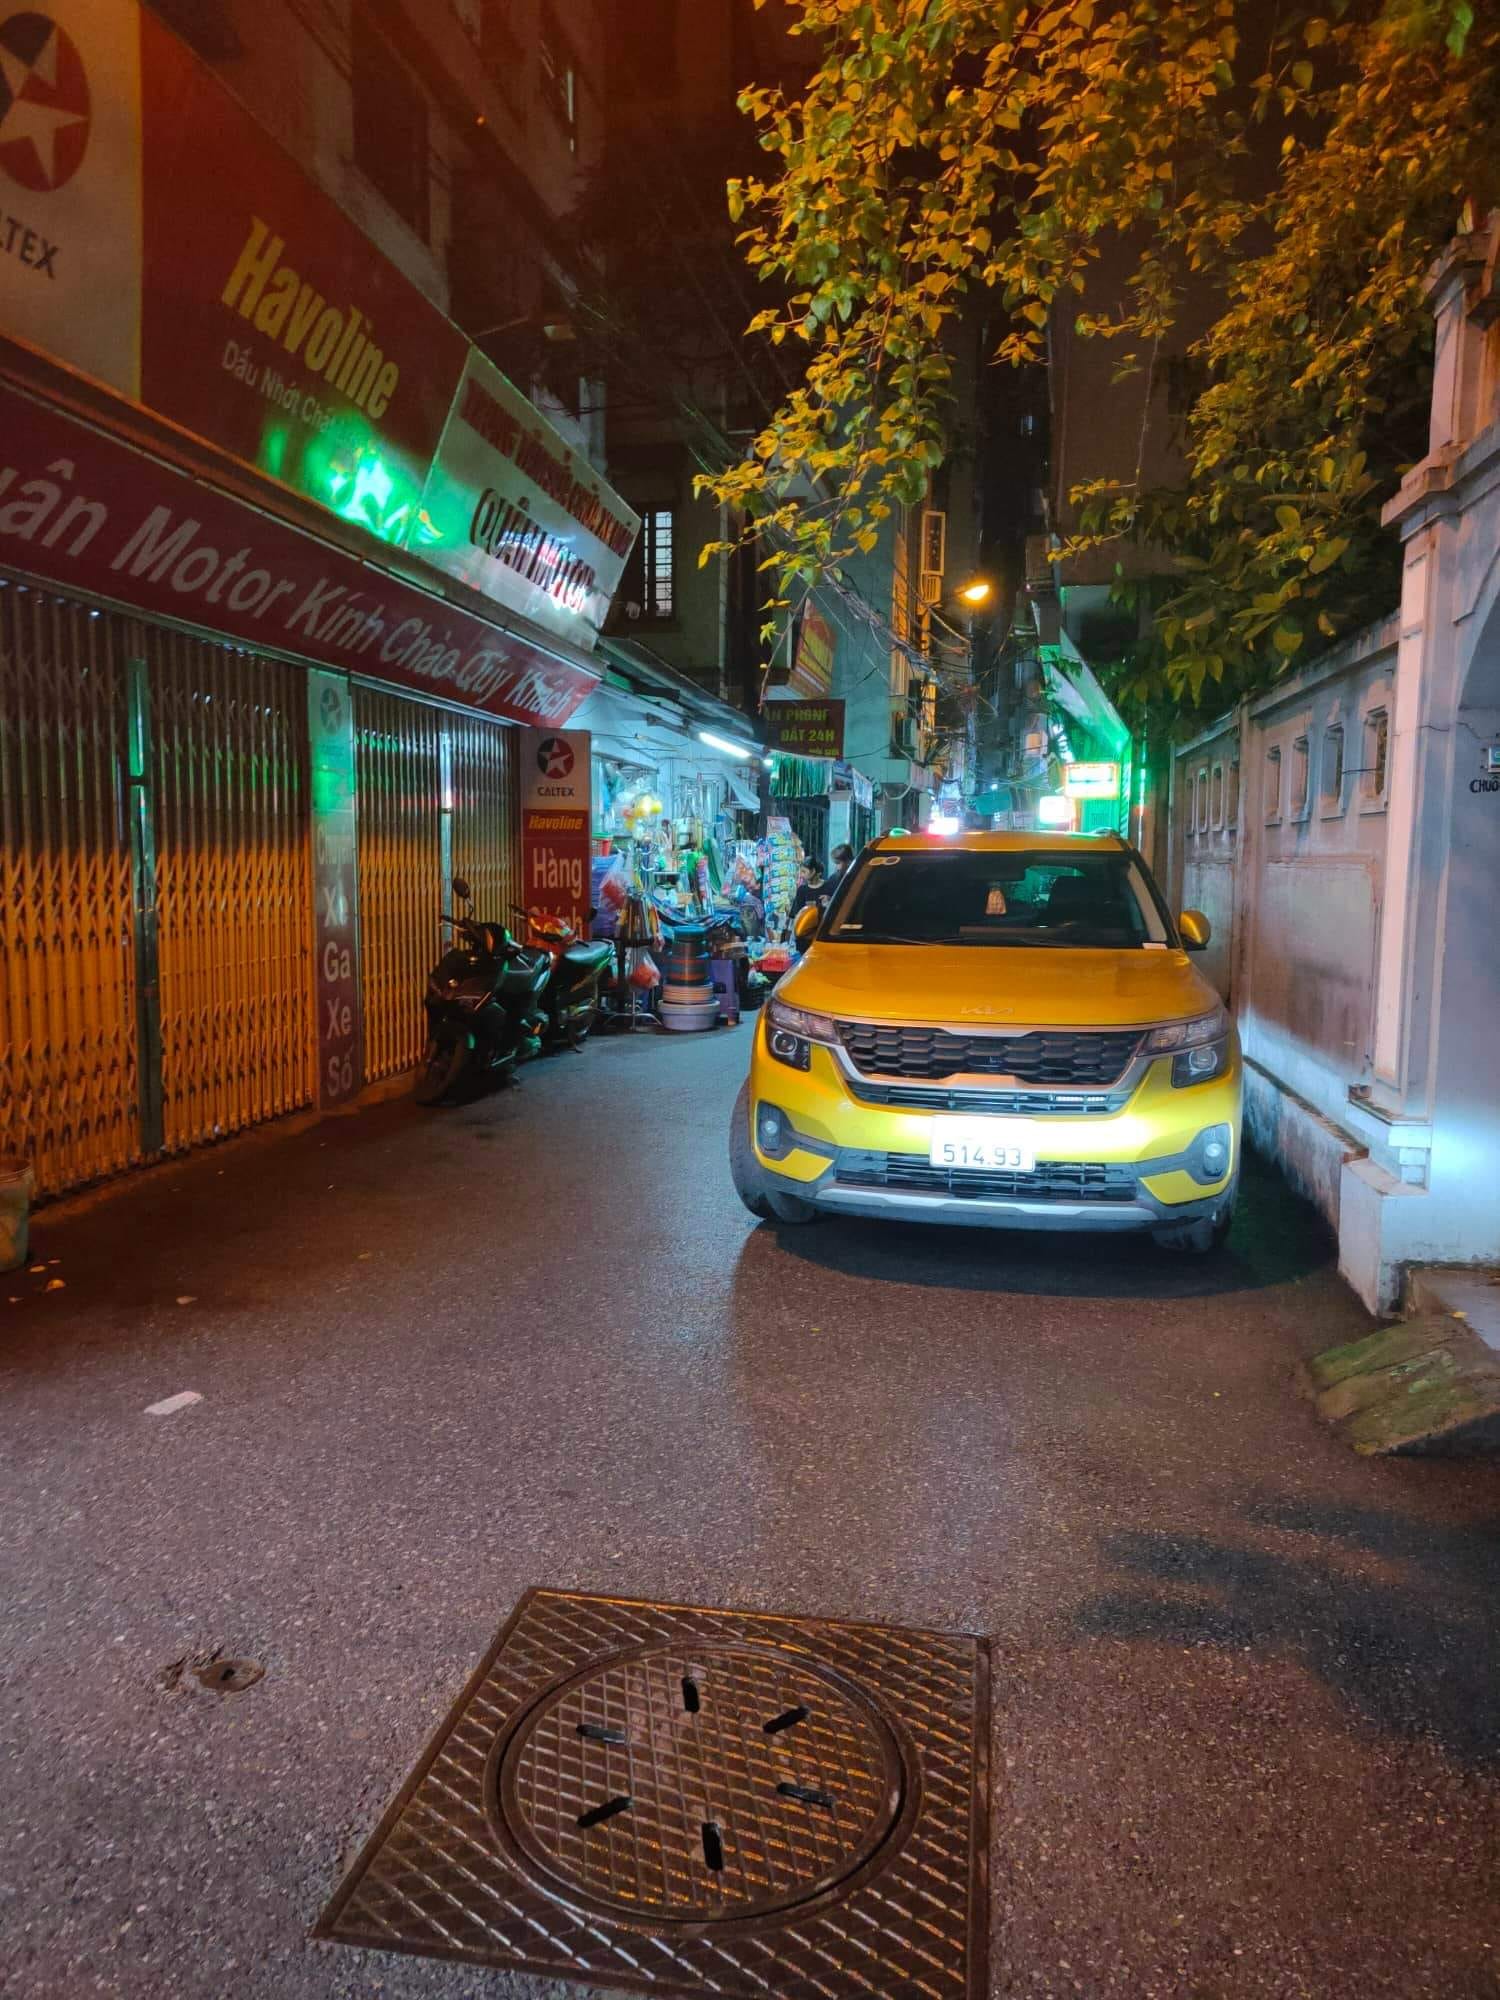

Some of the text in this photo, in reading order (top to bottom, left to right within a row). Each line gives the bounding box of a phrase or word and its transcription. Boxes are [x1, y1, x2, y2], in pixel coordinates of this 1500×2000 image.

[0, 212, 58, 279] TEX
[222, 215, 399, 419] Havoline
[0, 458, 108, 556] ân
[111, 505, 296, 619] Motor
[284, 577, 386, 654] Kính
[808, 730, 834, 742] 24H
[537, 786, 575, 797] CALTEX
[529, 815, 584, 830] Havoline
[533, 847, 583, 899] Hàng
[324, 940, 351, 982] Ga
[327, 998, 352, 1041] Xe
[328, 1042, 353, 1097] Số
[943, 1143, 1022, 1167] 514.93
